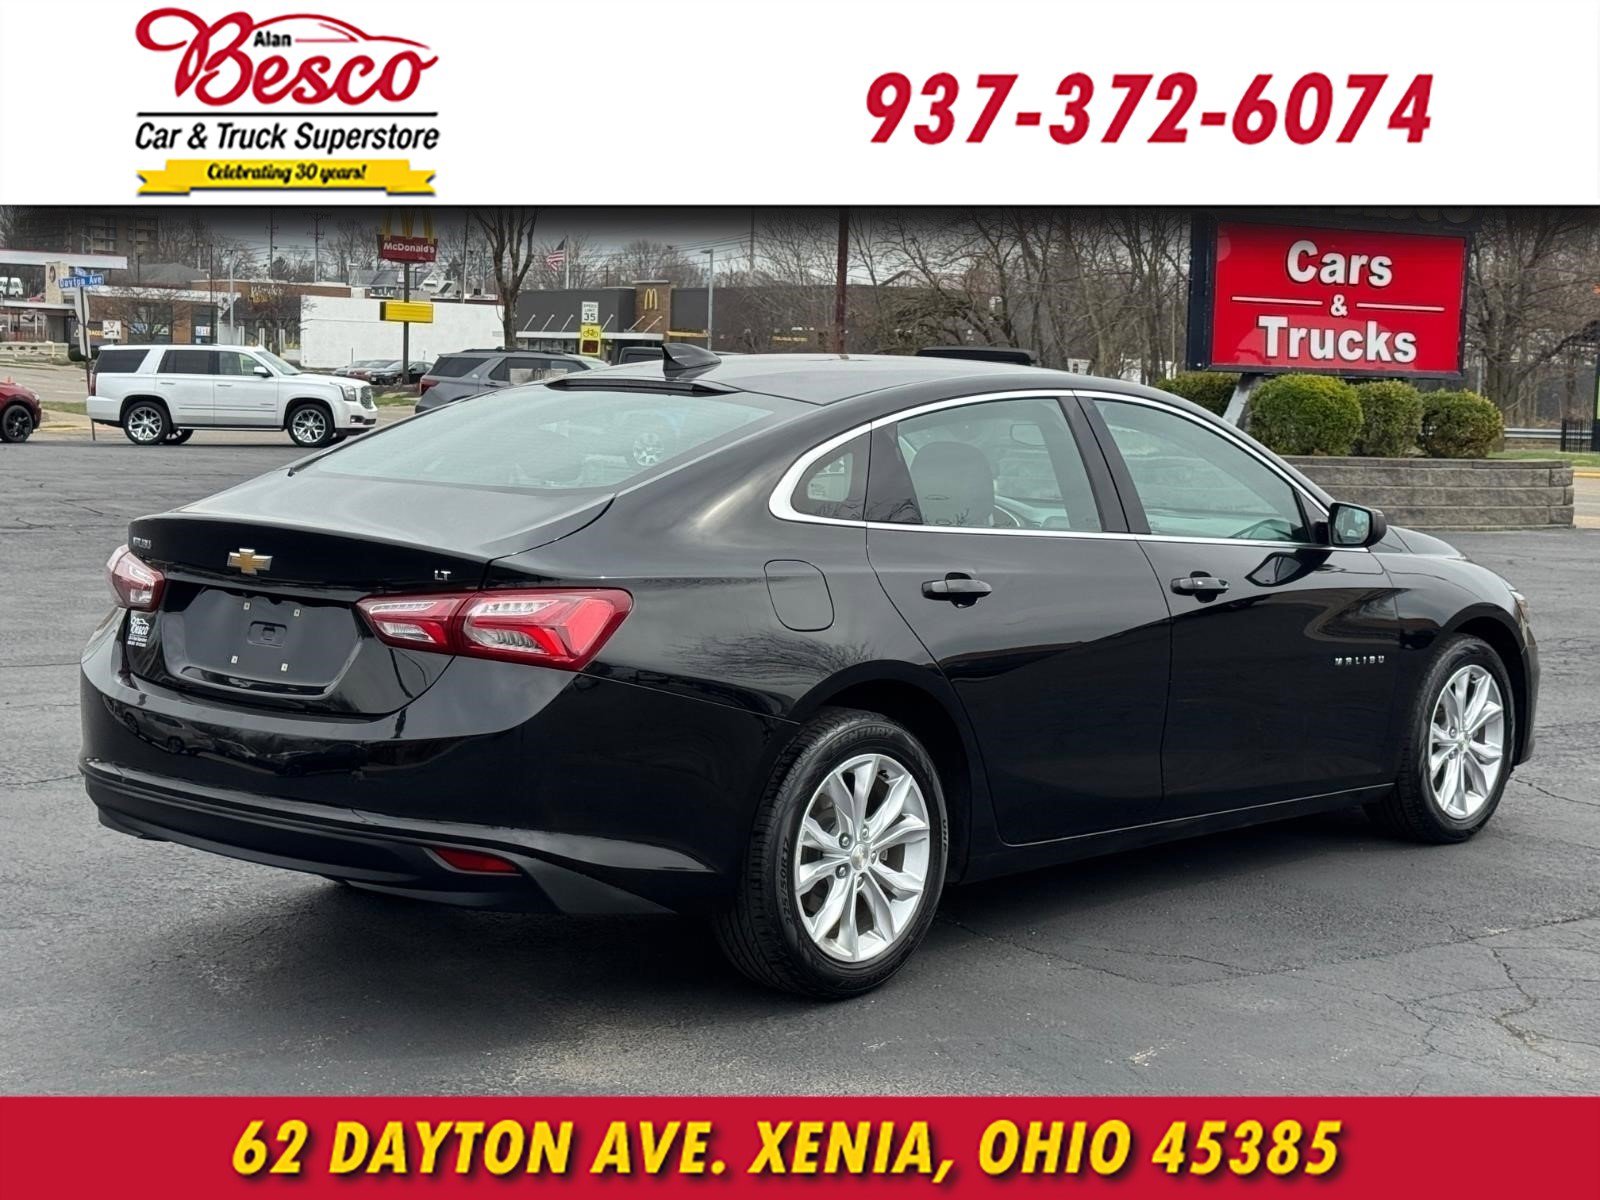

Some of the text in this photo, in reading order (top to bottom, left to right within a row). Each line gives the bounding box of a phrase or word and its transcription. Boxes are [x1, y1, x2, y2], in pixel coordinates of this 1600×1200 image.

[384, 242, 435, 254] McDonald's
[1287, 240, 1393, 287] Cars
[1330, 294, 1348, 317] &
[584, 312, 596, 321] 35
[1258, 314, 1417, 364] Trucks
[434, 570, 450, 581] LT
[1335, 655, 1385, 666] MALIBU
